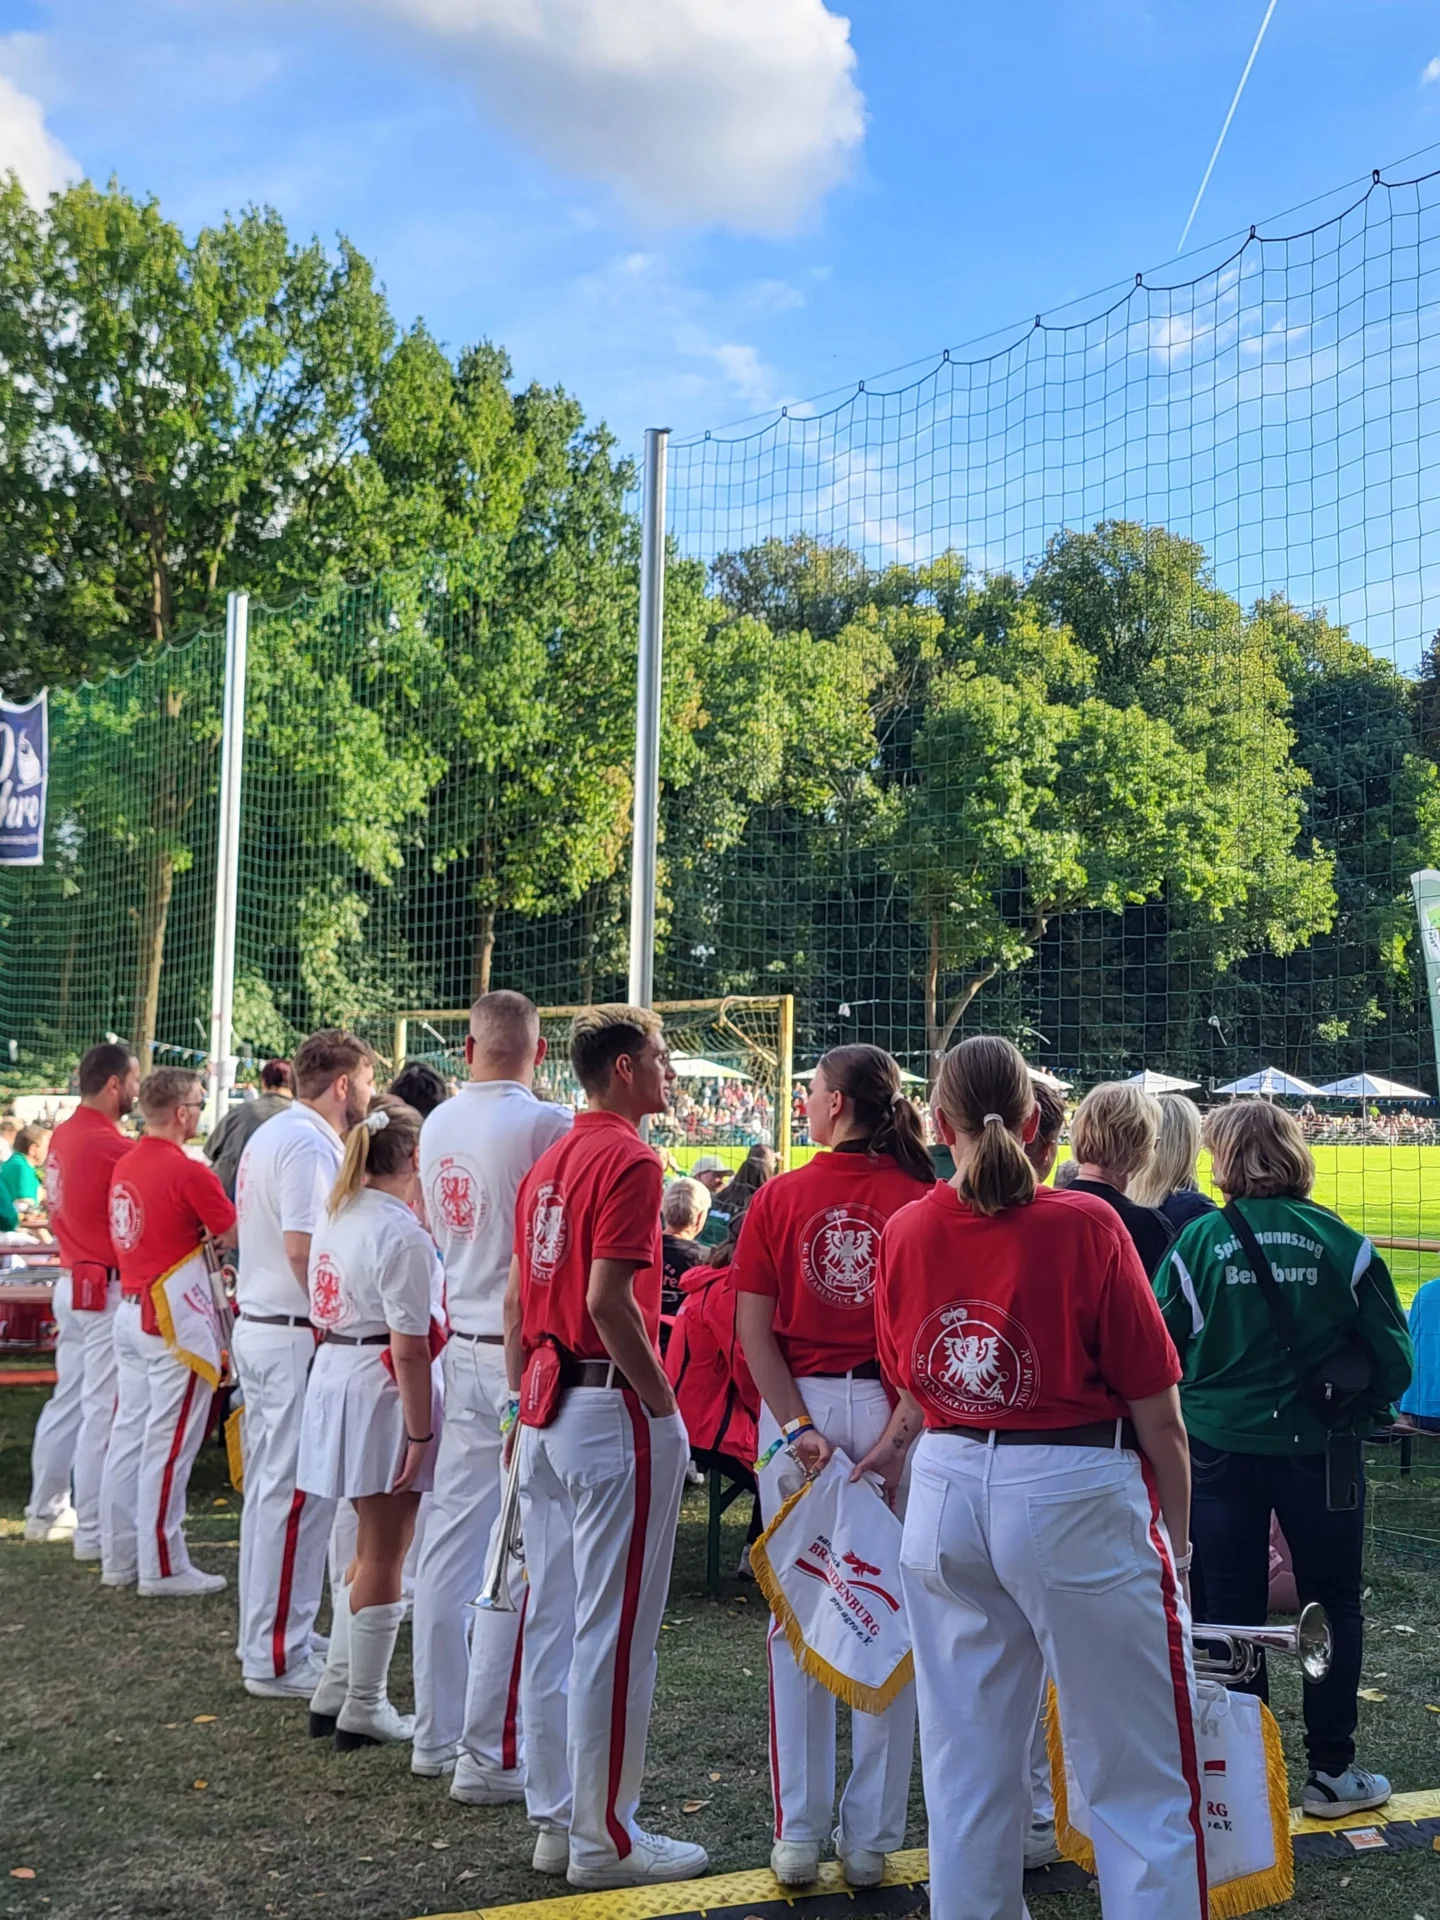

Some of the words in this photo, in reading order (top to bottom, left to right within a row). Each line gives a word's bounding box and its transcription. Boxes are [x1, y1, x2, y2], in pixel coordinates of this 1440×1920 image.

[1214, 1231, 1324, 1260] Spimannszug
[1225, 1262, 1318, 1286] Beburg
[916, 1352, 926, 1369] SG
[808, 1542, 881, 1637] BRANDENBURG
[829, 1596, 843, 1613] pro
[841, 1611, 859, 1631] agro
[856, 1631, 875, 1647] e.V.
